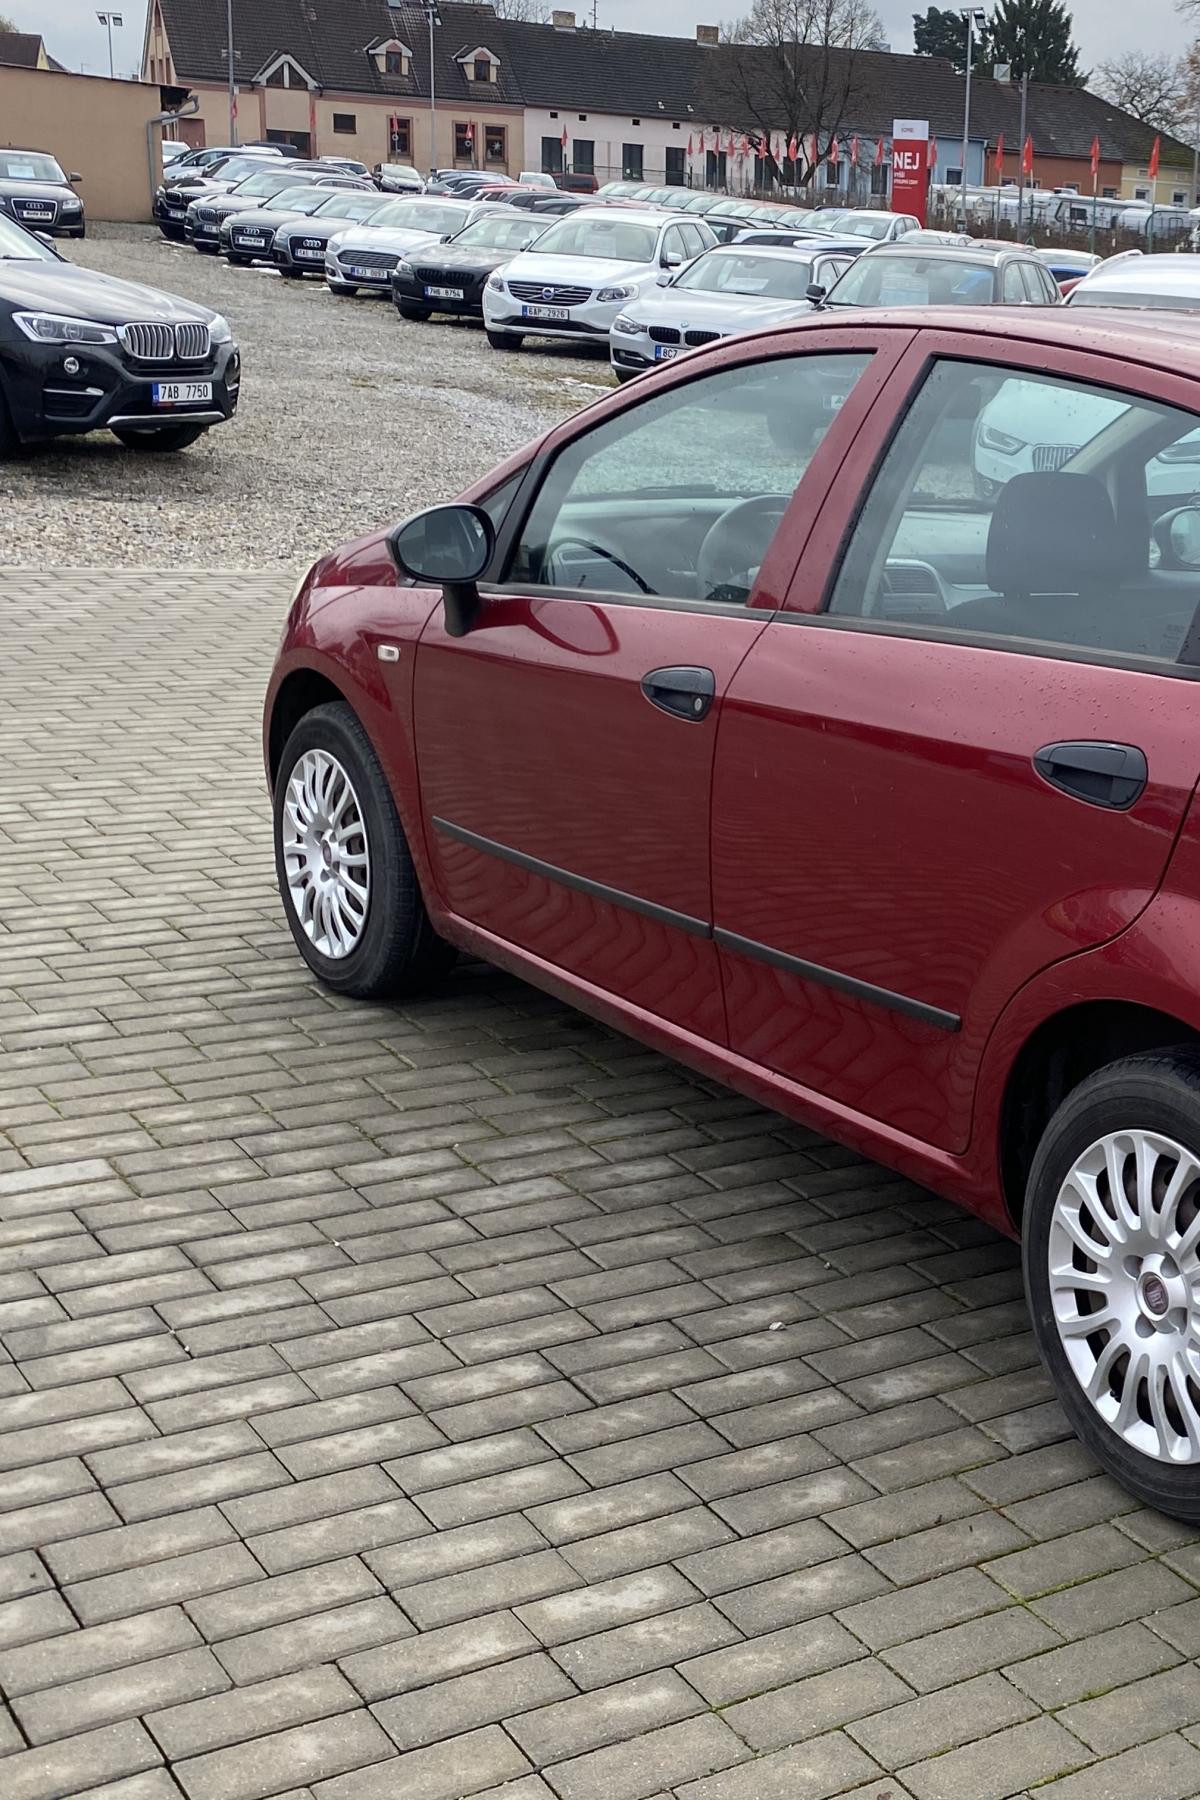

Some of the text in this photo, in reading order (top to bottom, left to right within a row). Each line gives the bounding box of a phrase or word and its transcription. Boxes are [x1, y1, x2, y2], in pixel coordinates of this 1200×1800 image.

[894, 151, 920, 170] NEJ
[161, 384, 209, 399] 7AB 7750
